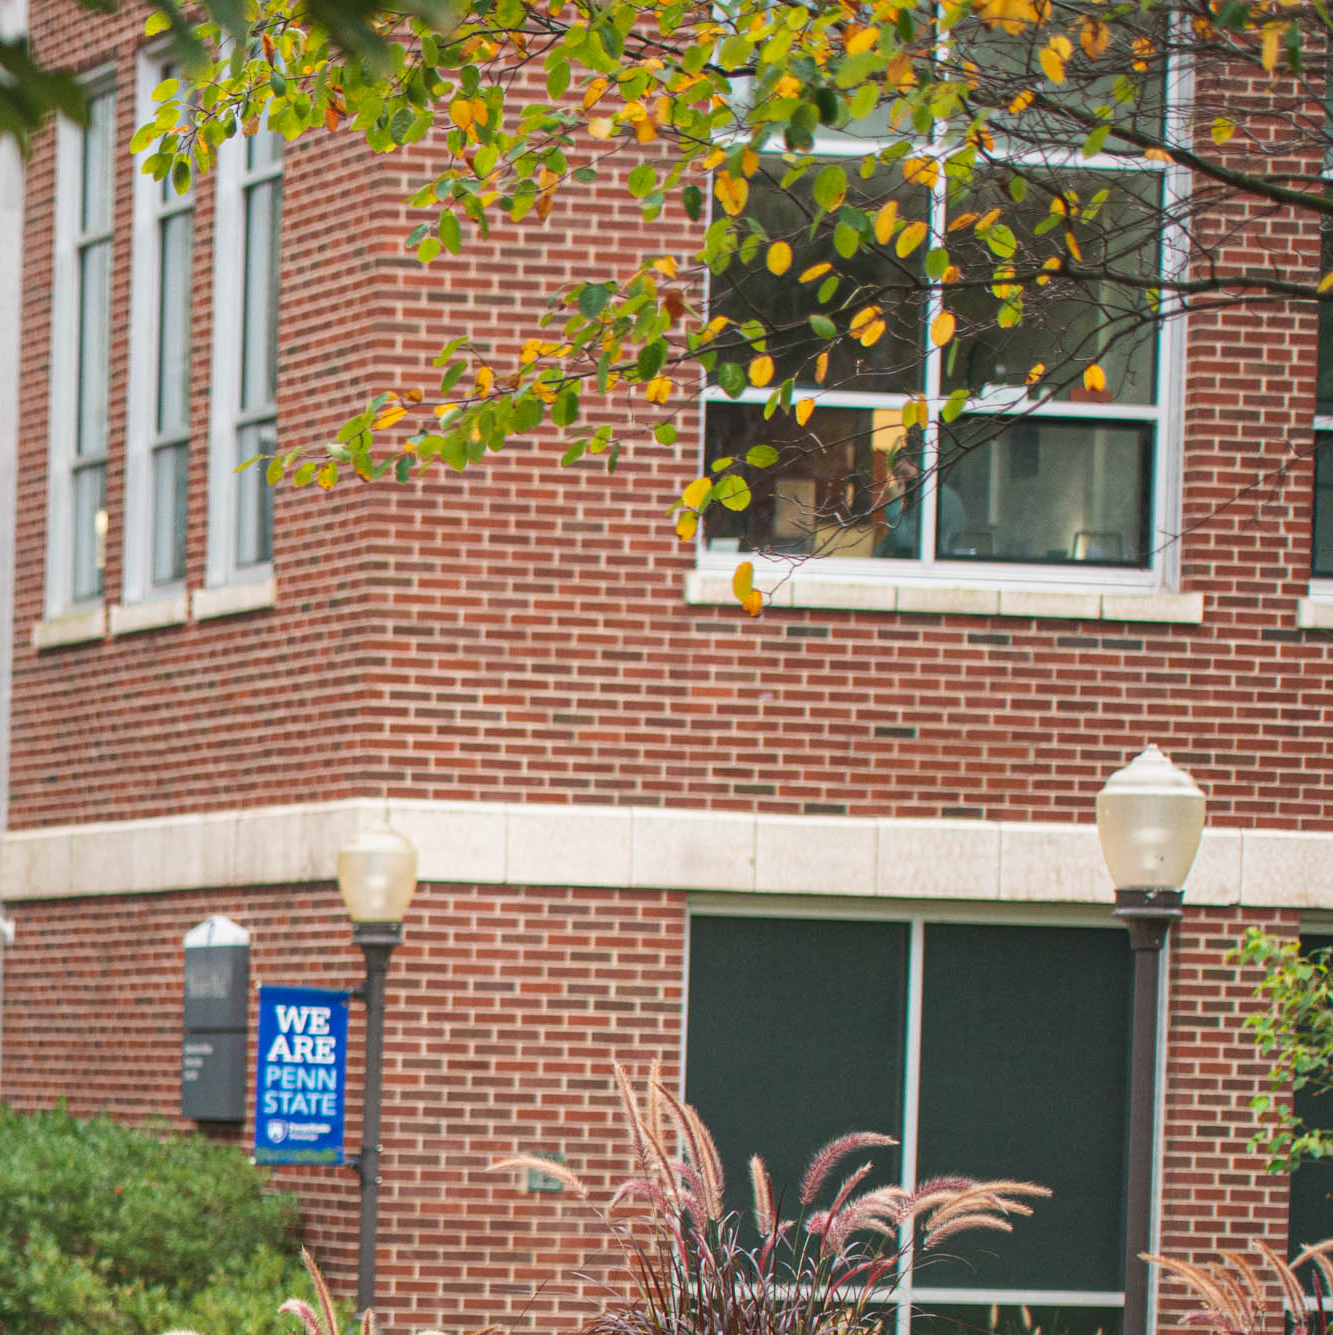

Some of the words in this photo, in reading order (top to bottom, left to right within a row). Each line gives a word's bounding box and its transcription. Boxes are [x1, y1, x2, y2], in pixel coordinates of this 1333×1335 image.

[276, 1005, 331, 1034] WE
[267, 1033, 336, 1064] ARE
[267, 1066, 336, 1090] PENN
[265, 1091, 336, 1115] STATE
